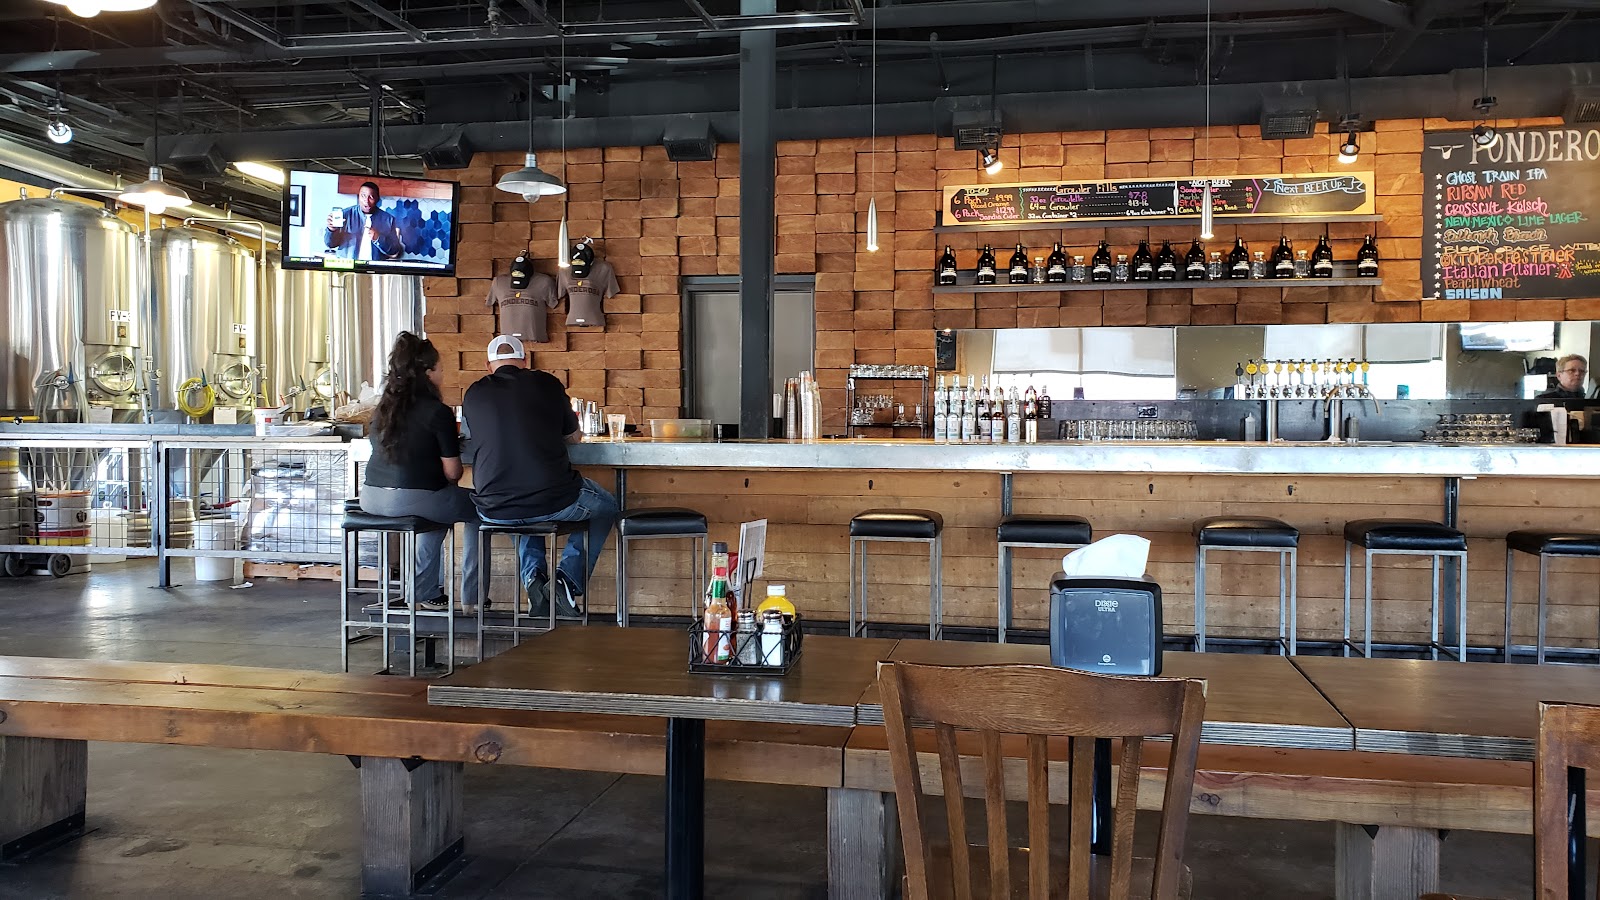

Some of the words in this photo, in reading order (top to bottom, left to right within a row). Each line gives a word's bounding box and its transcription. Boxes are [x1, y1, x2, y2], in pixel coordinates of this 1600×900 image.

[1482, 170, 1520, 183] TRAIN
[1526, 168, 1548, 180] IPA
[1056, 184, 1091, 194] Growler
[1096, 182, 1118, 193] Fills
[1276, 184, 1298, 193] Next
[1304, 181, 1328, 192] BEER
[1446, 184, 1494, 201] RIPSAW
[1500, 183, 1526, 200] RED
[954, 196, 961, 204] 6
[954, 209, 962, 218] 6
[1518, 215, 1545, 227] LIME
[1549, 211, 1588, 224] LAGER
[1442, 264, 1499, 279] Italian
[1502, 262, 1556, 277] Pilsner
[1446, 288, 1502, 299] SAISON
